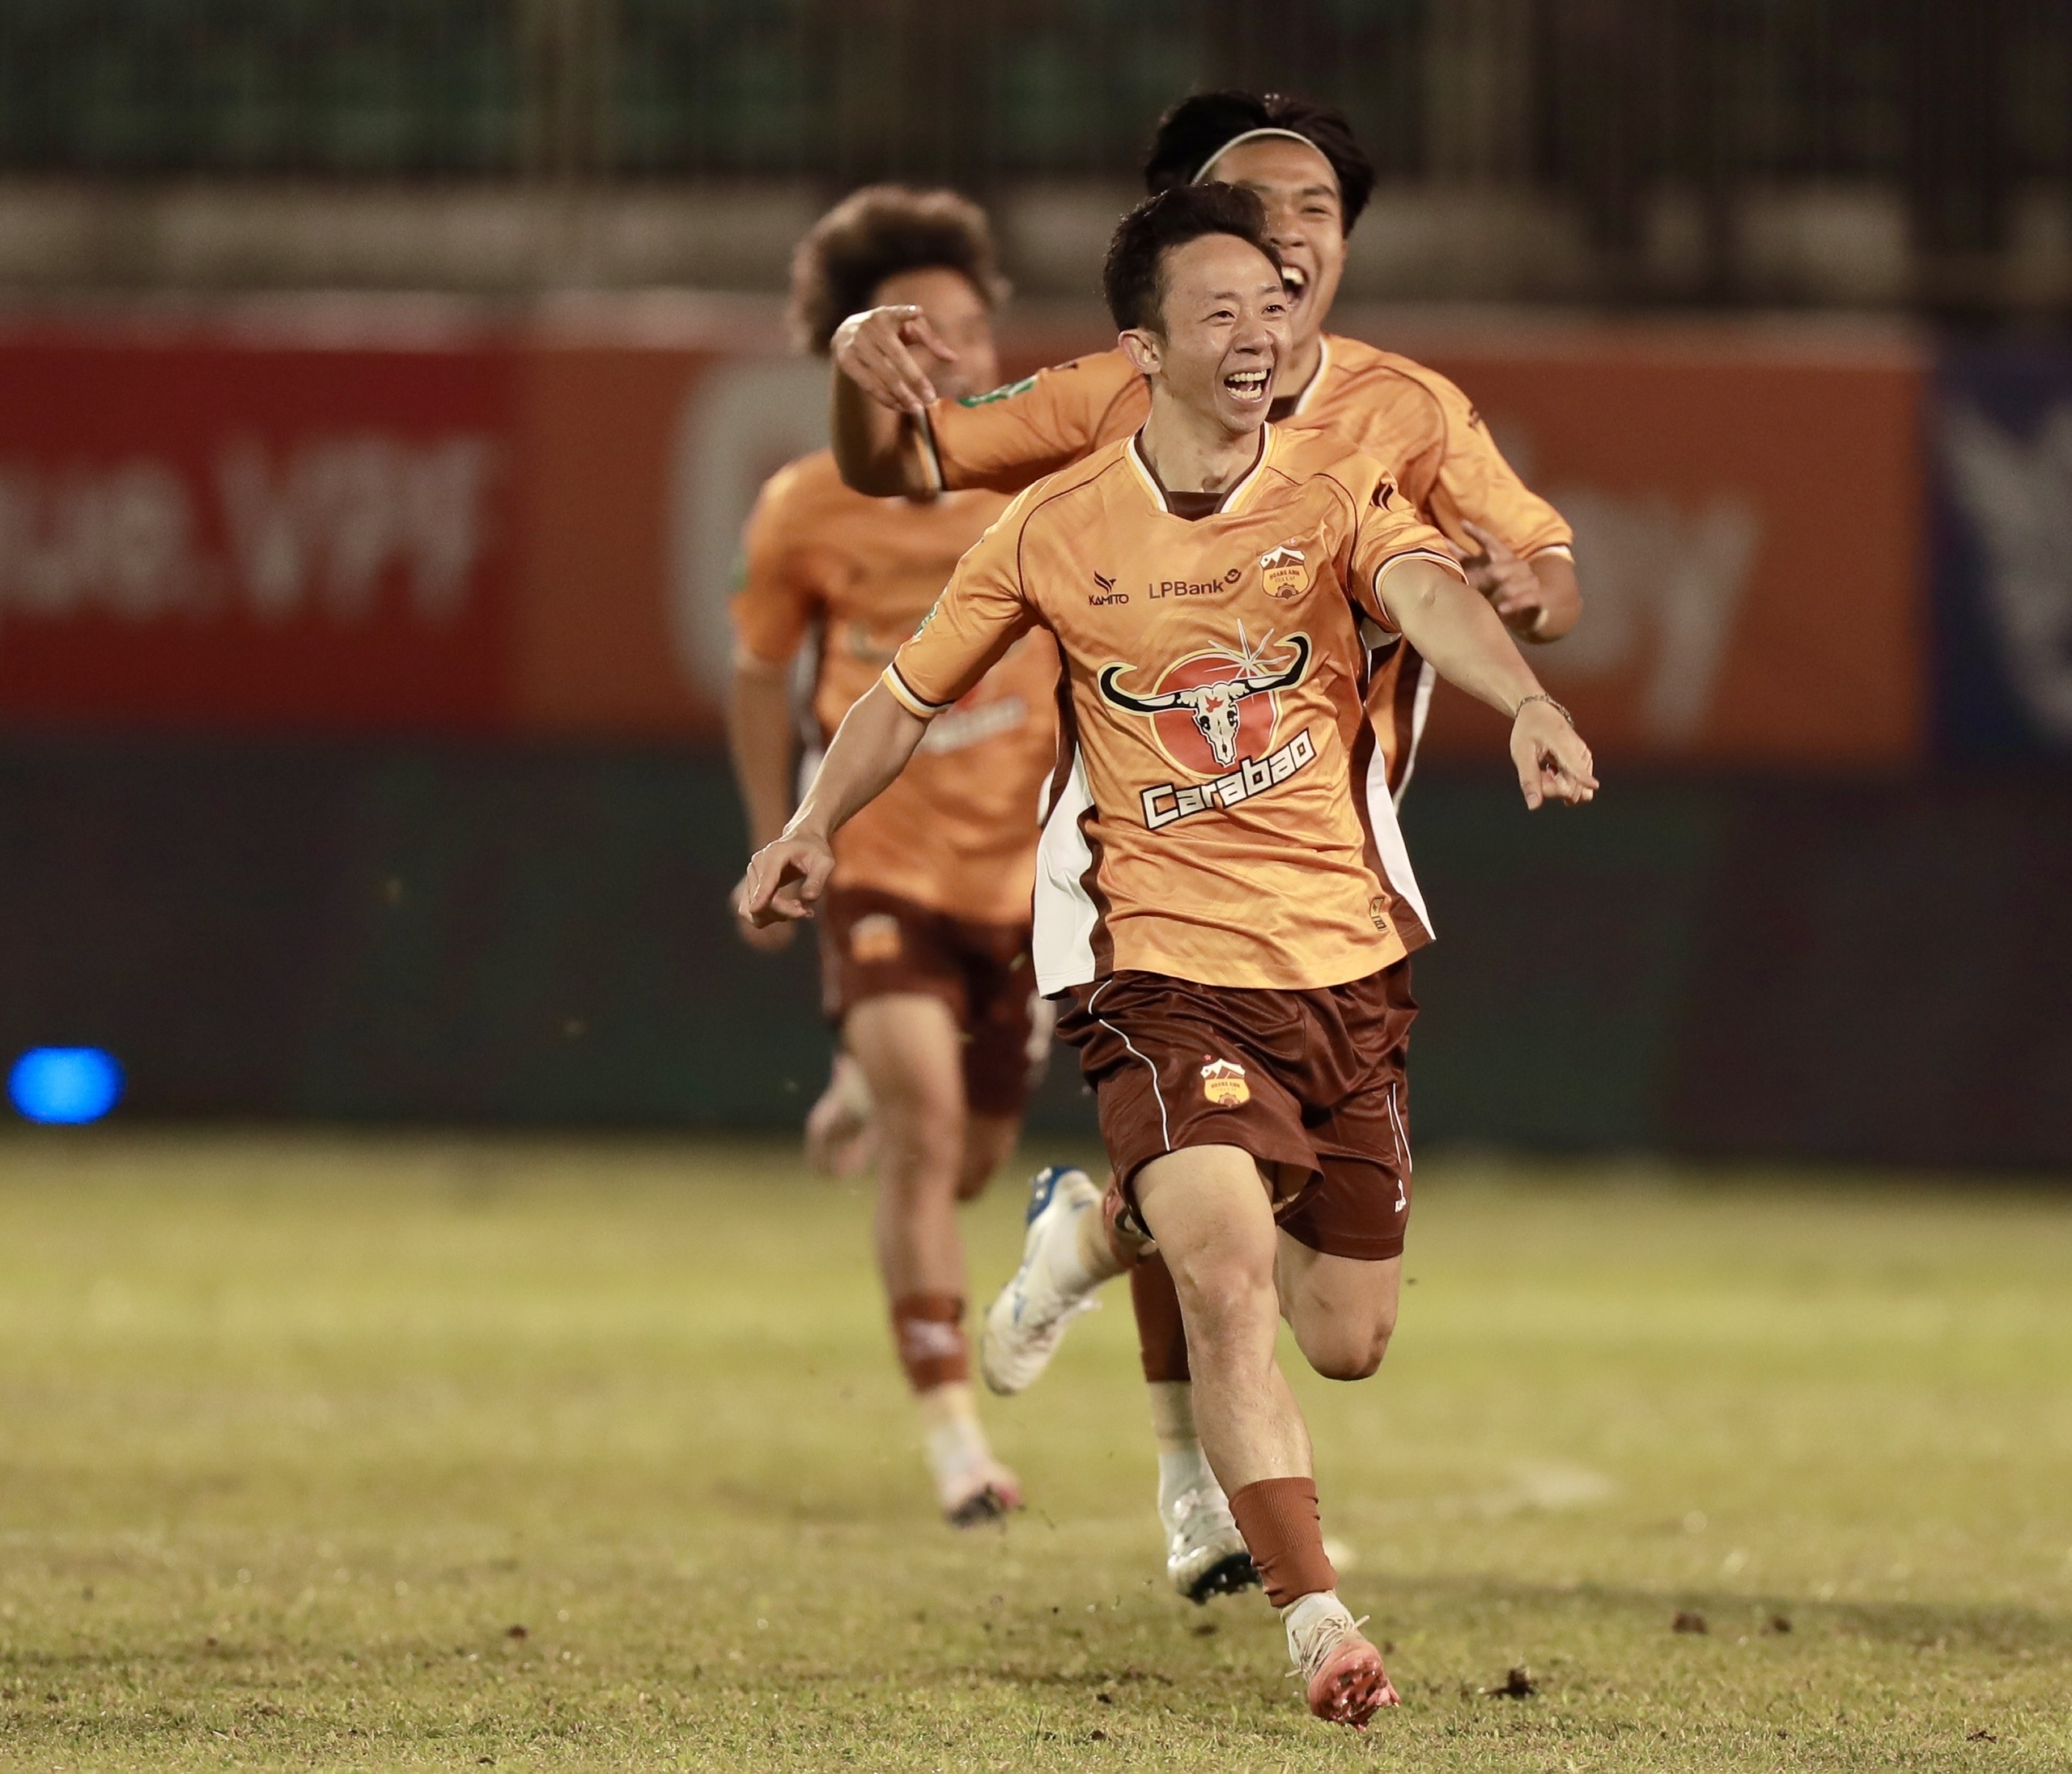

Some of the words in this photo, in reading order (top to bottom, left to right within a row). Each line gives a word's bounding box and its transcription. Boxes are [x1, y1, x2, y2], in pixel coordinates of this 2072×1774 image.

[1089, 594, 1129, 605] KAMITO
[1149, 579, 1225, 600] LPBank
[1140, 727, 1318, 830] Carabao
